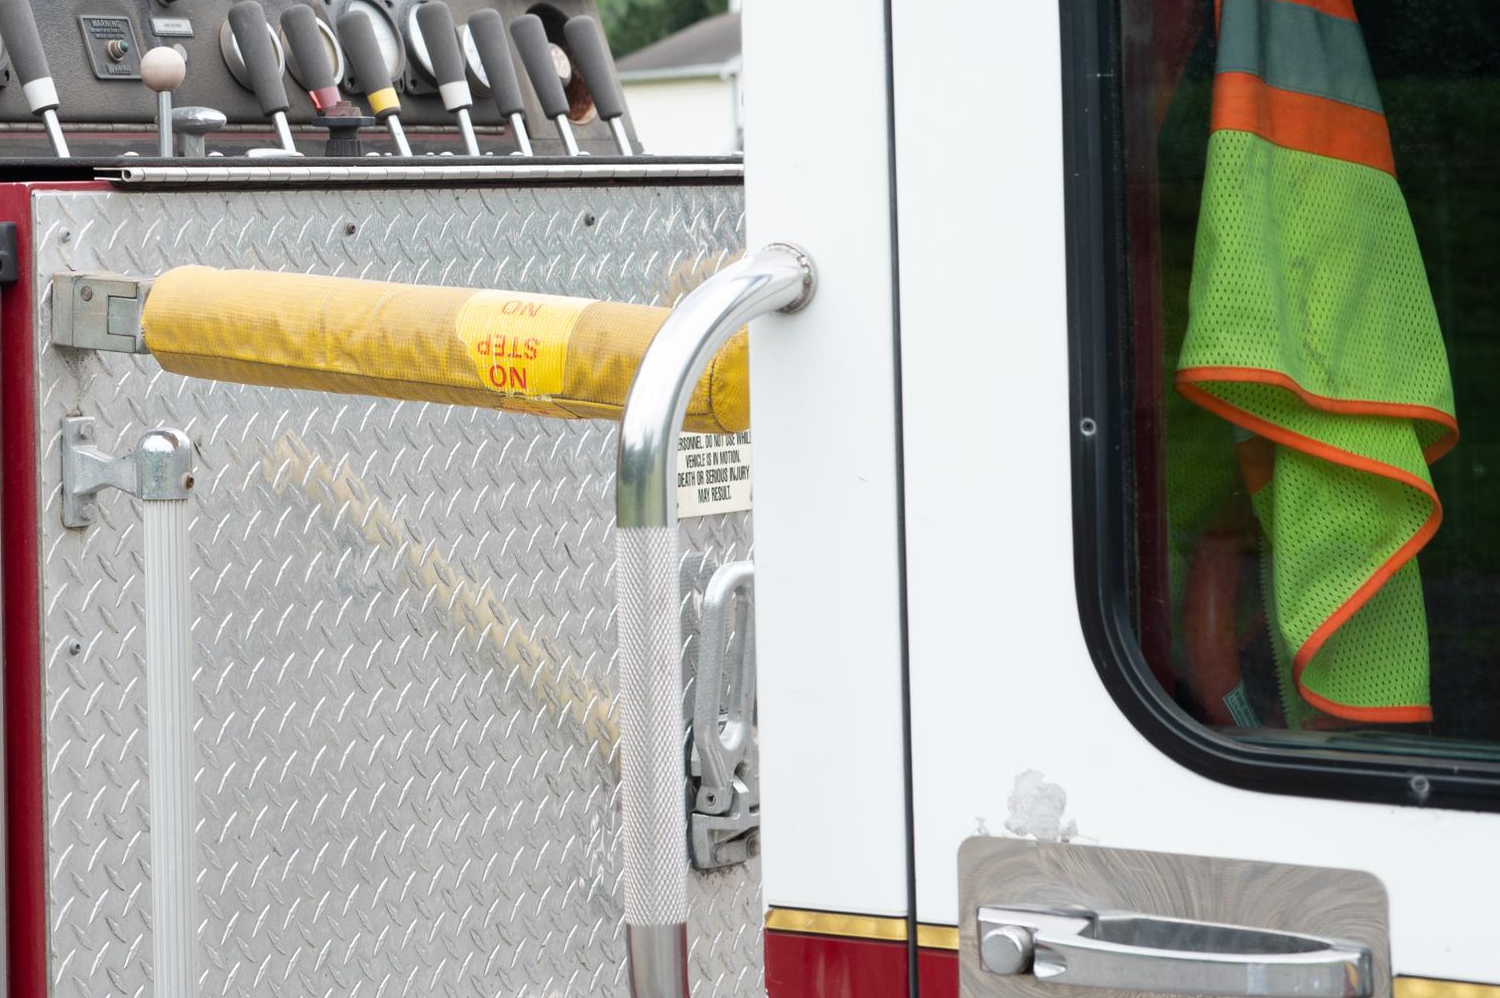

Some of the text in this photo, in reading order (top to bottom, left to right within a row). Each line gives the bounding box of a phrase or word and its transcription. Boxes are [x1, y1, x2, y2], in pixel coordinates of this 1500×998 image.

[477, 334, 540, 360] STEP
[489, 364, 527, 389] NO
[705, 434, 713, 448] DO
[713, 433, 724, 448] NOT
[725, 434, 735, 446] USE
[736, 431, 752, 445] WHIL
[685, 450, 741, 469] VEHICLE IS IN MOTION.
[677, 465, 750, 488] DEATH OR SERIOUS INJURY
[697, 485, 732, 503] MAY RESULT.
